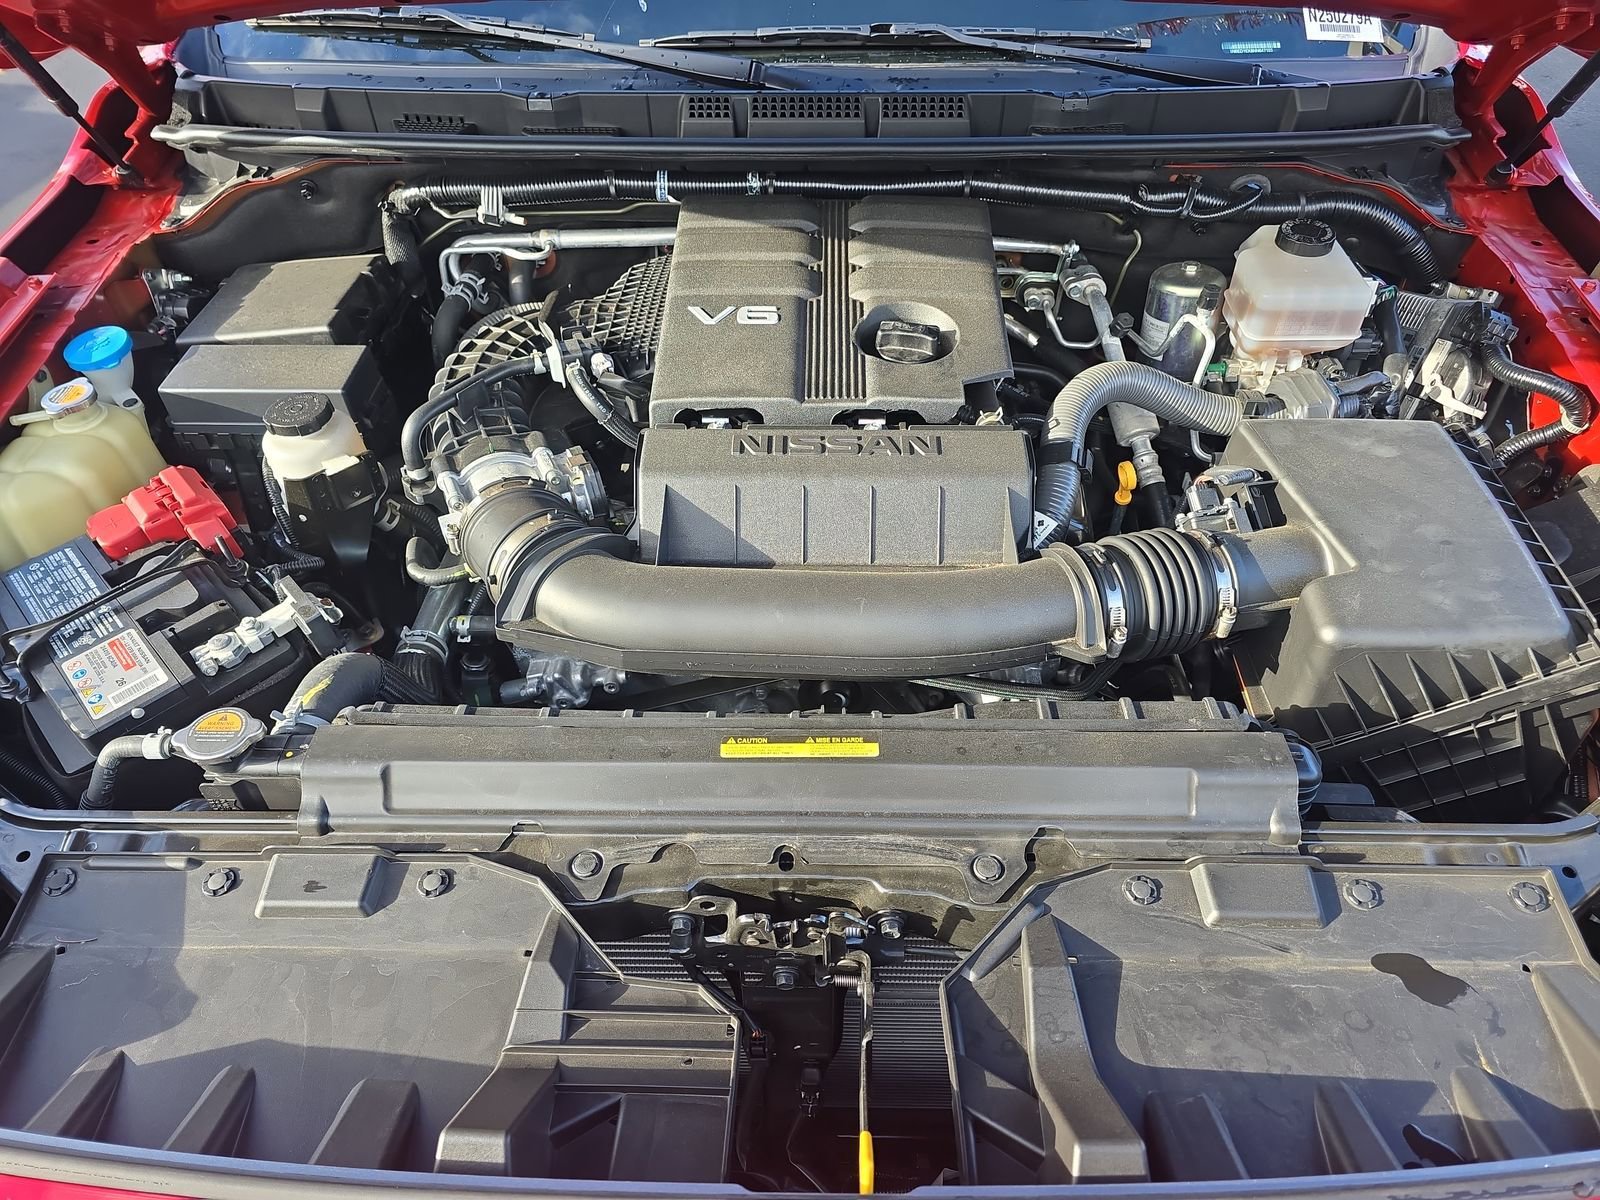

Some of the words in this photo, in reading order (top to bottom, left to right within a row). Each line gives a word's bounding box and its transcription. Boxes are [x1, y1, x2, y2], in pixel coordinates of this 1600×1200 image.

[687, 305, 780, 325] V6
[731, 435, 942, 456] NISSAN
[115, 676, 127, 687] 26
